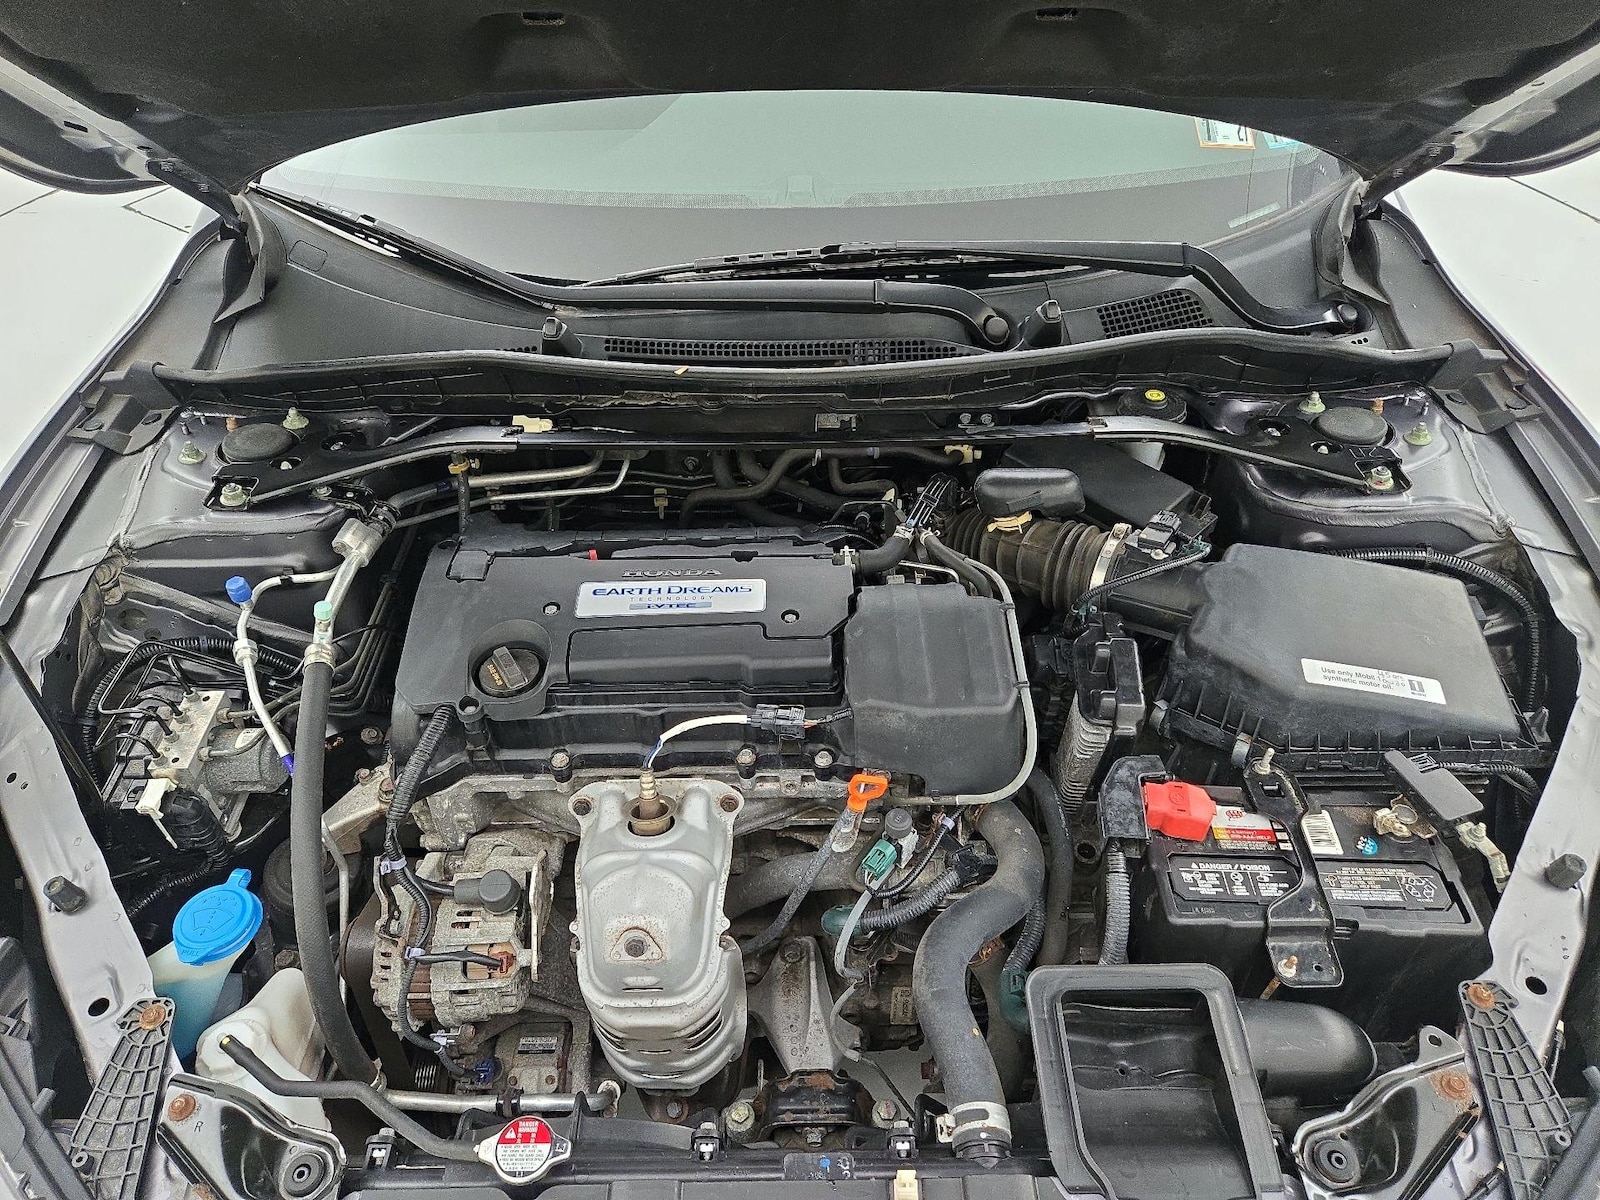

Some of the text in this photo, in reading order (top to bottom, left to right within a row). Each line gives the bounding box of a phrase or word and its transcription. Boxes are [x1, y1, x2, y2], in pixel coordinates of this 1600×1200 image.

[622, 569, 722, 577] HONDA
[592, 585, 752, 596] EARTH DREAMS
[1337, 670, 1353, 678] only
[1355, 672, 1376, 681] Mobil
[1323, 675, 1357, 684] synthetic
[1358, 680, 1380, 688] motor
[1199, 862, 1232, 870] DANGER
[1240, 864, 1271, 872] POISON
[193, 1120, 204, 1132] R
